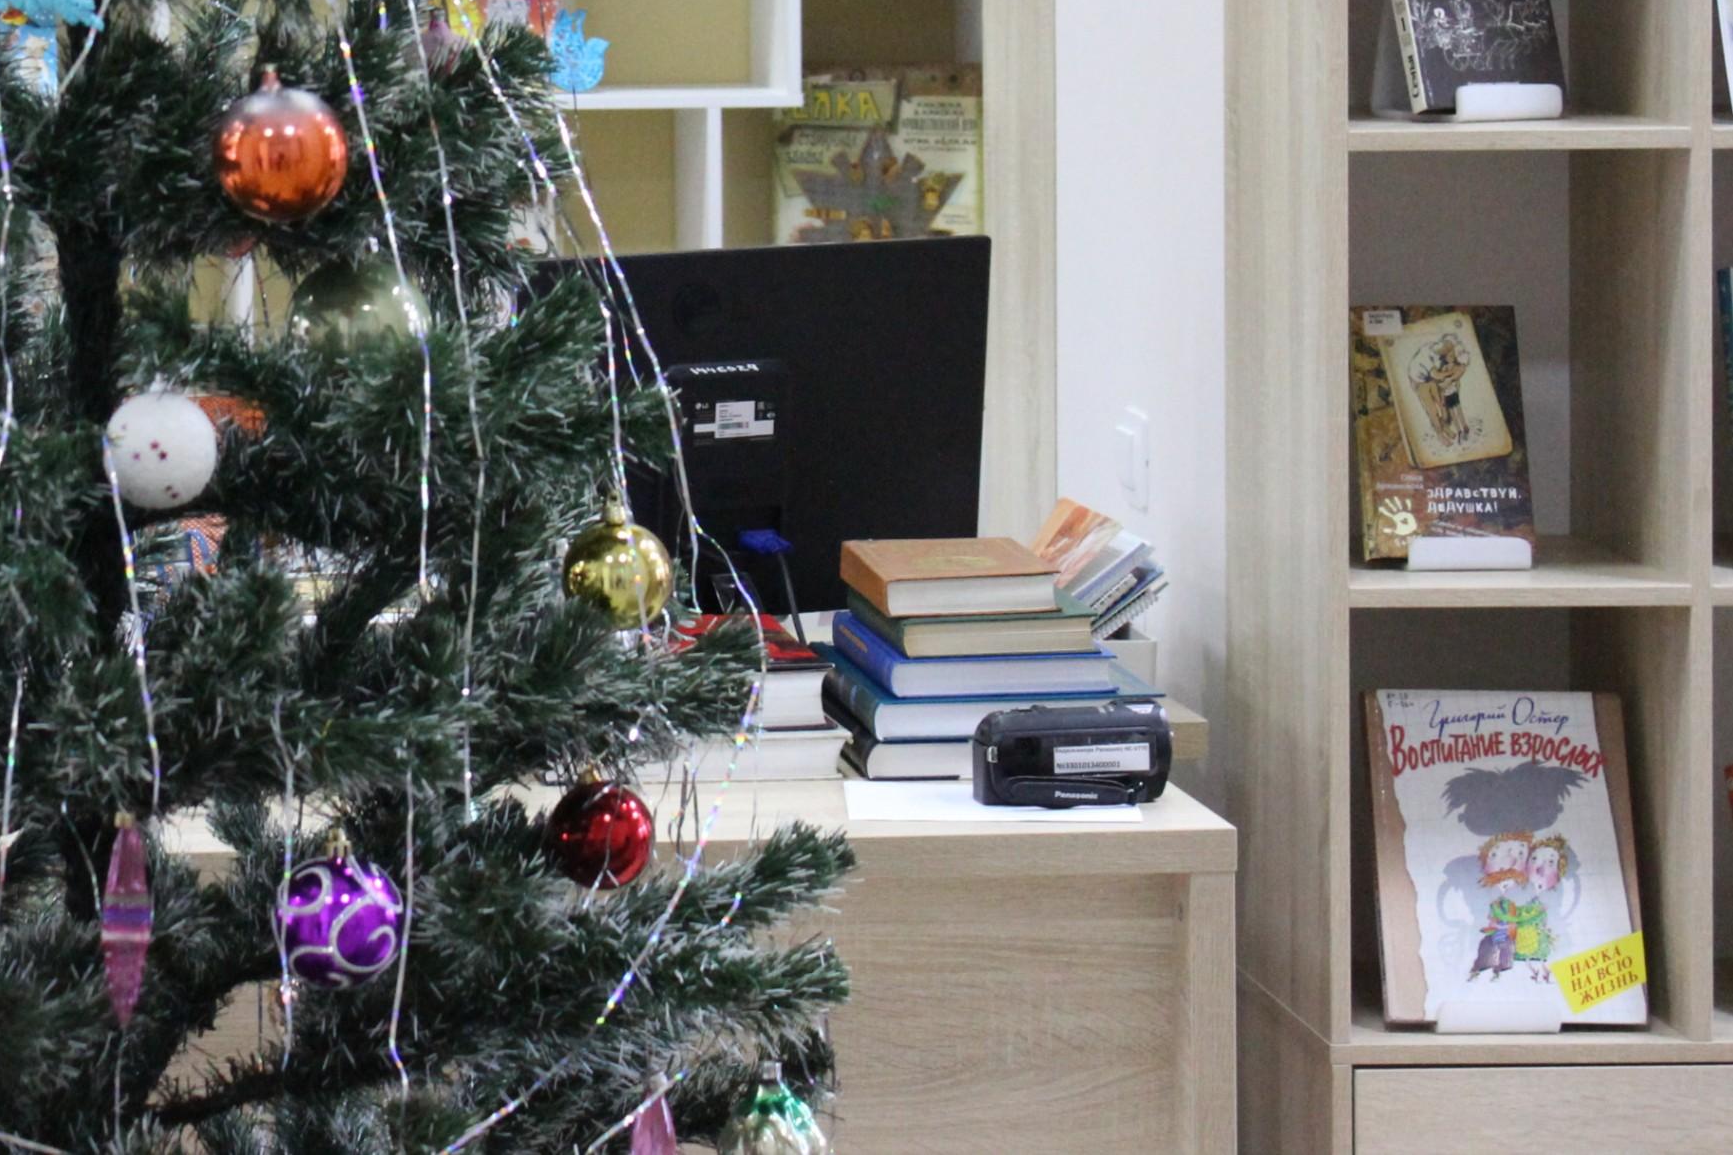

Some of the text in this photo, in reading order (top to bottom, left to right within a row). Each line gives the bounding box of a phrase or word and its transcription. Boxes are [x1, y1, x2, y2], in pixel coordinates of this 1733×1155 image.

[792, 90, 881, 121] ЛКА
[1424, 696, 1569, 739] Григорий Остер
[1054, 790, 1098, 800] Panasonic
[1570, 945, 1621, 976] НАУКА
[1571, 956, 1633, 992] НА ВСЮ
[1580, 971, 1638, 1005] ЖИЗНЬ
